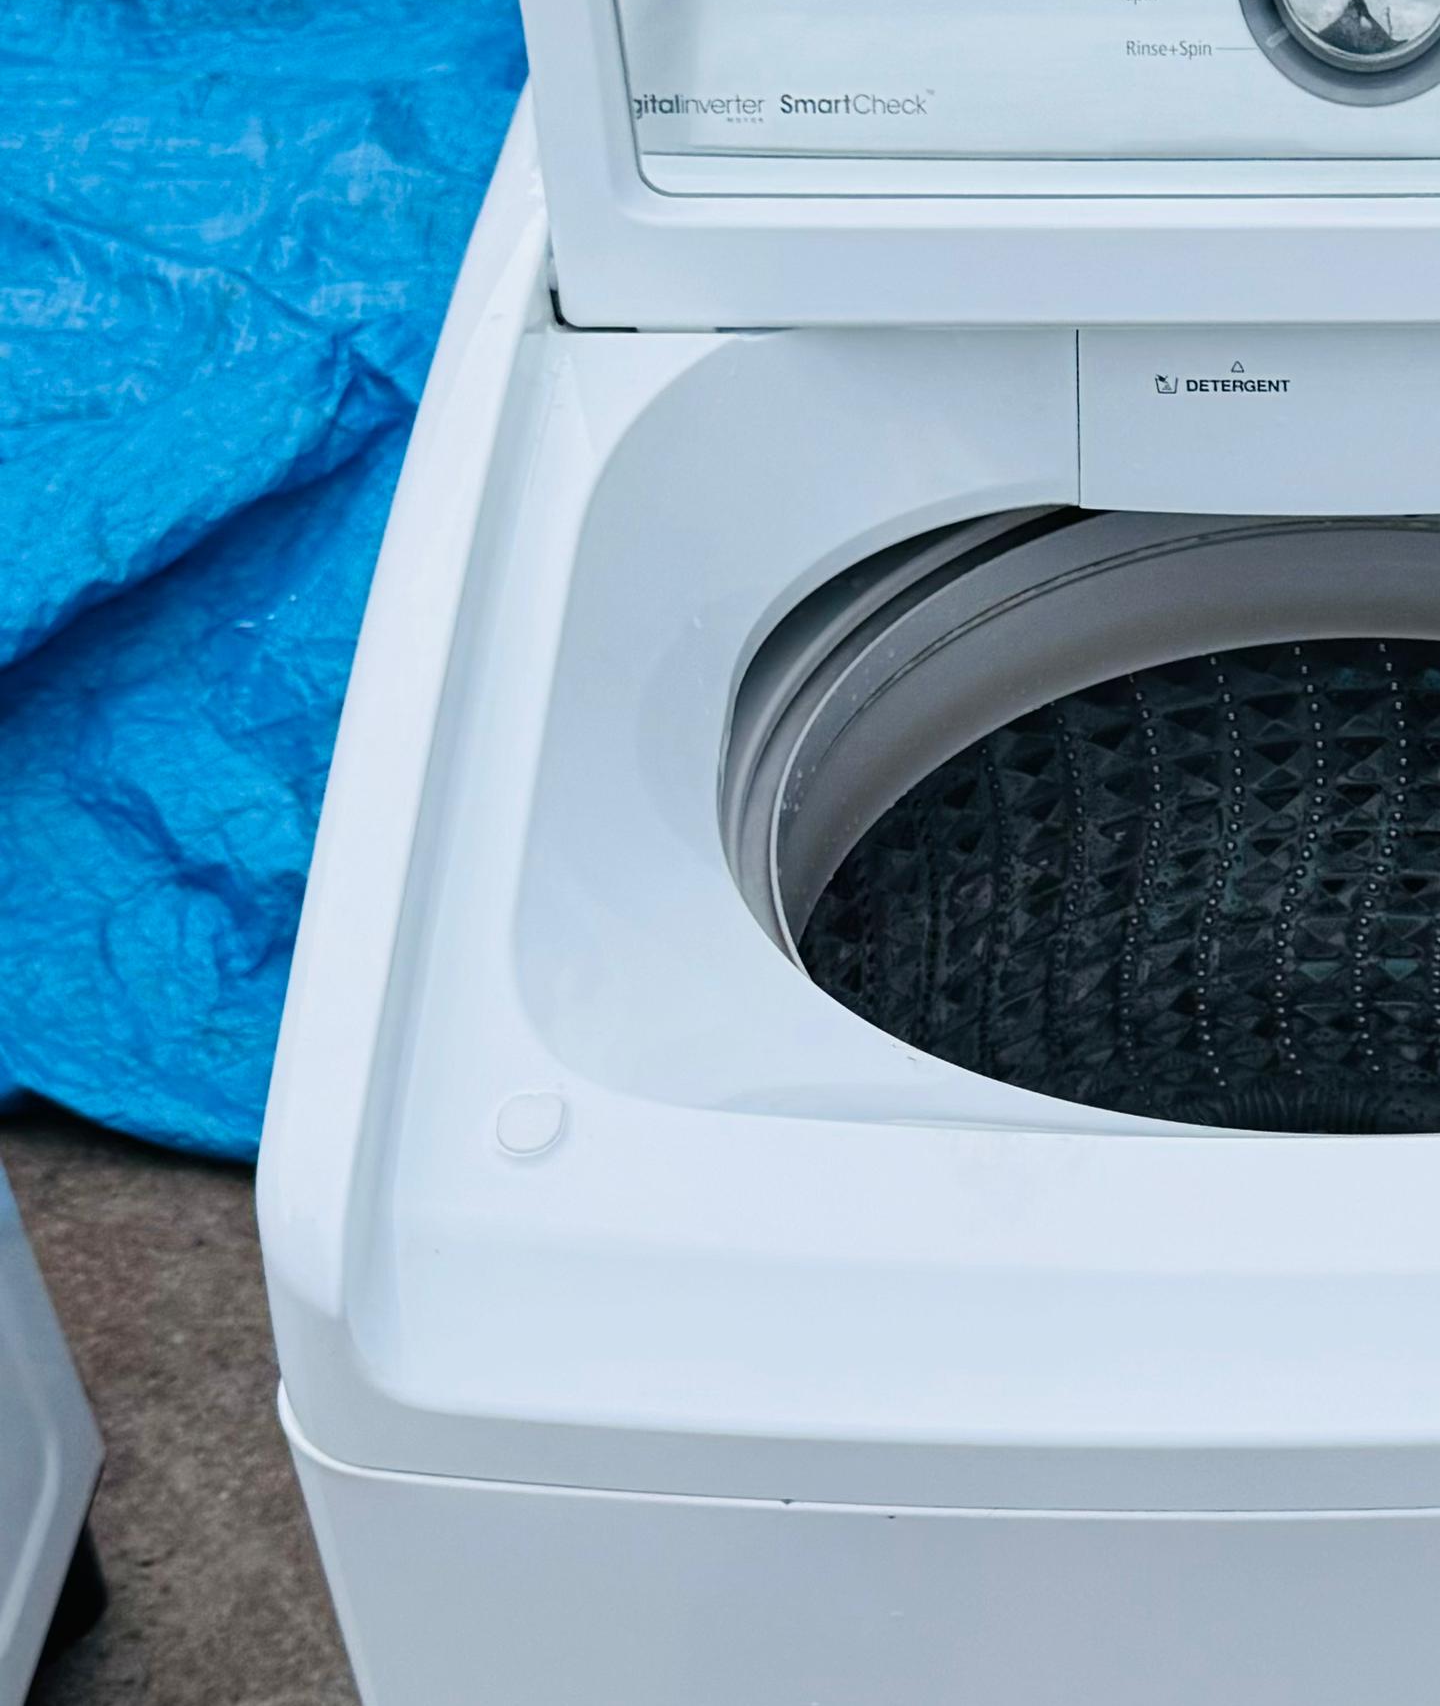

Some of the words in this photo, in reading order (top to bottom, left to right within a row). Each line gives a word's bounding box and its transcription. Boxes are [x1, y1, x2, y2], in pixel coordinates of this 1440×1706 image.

[1126, 40, 1212, 59] Rinse+Spin
[780, 94, 928, 115] SmartCheck
[1186, 379, 1290, 392] DETERGENT
